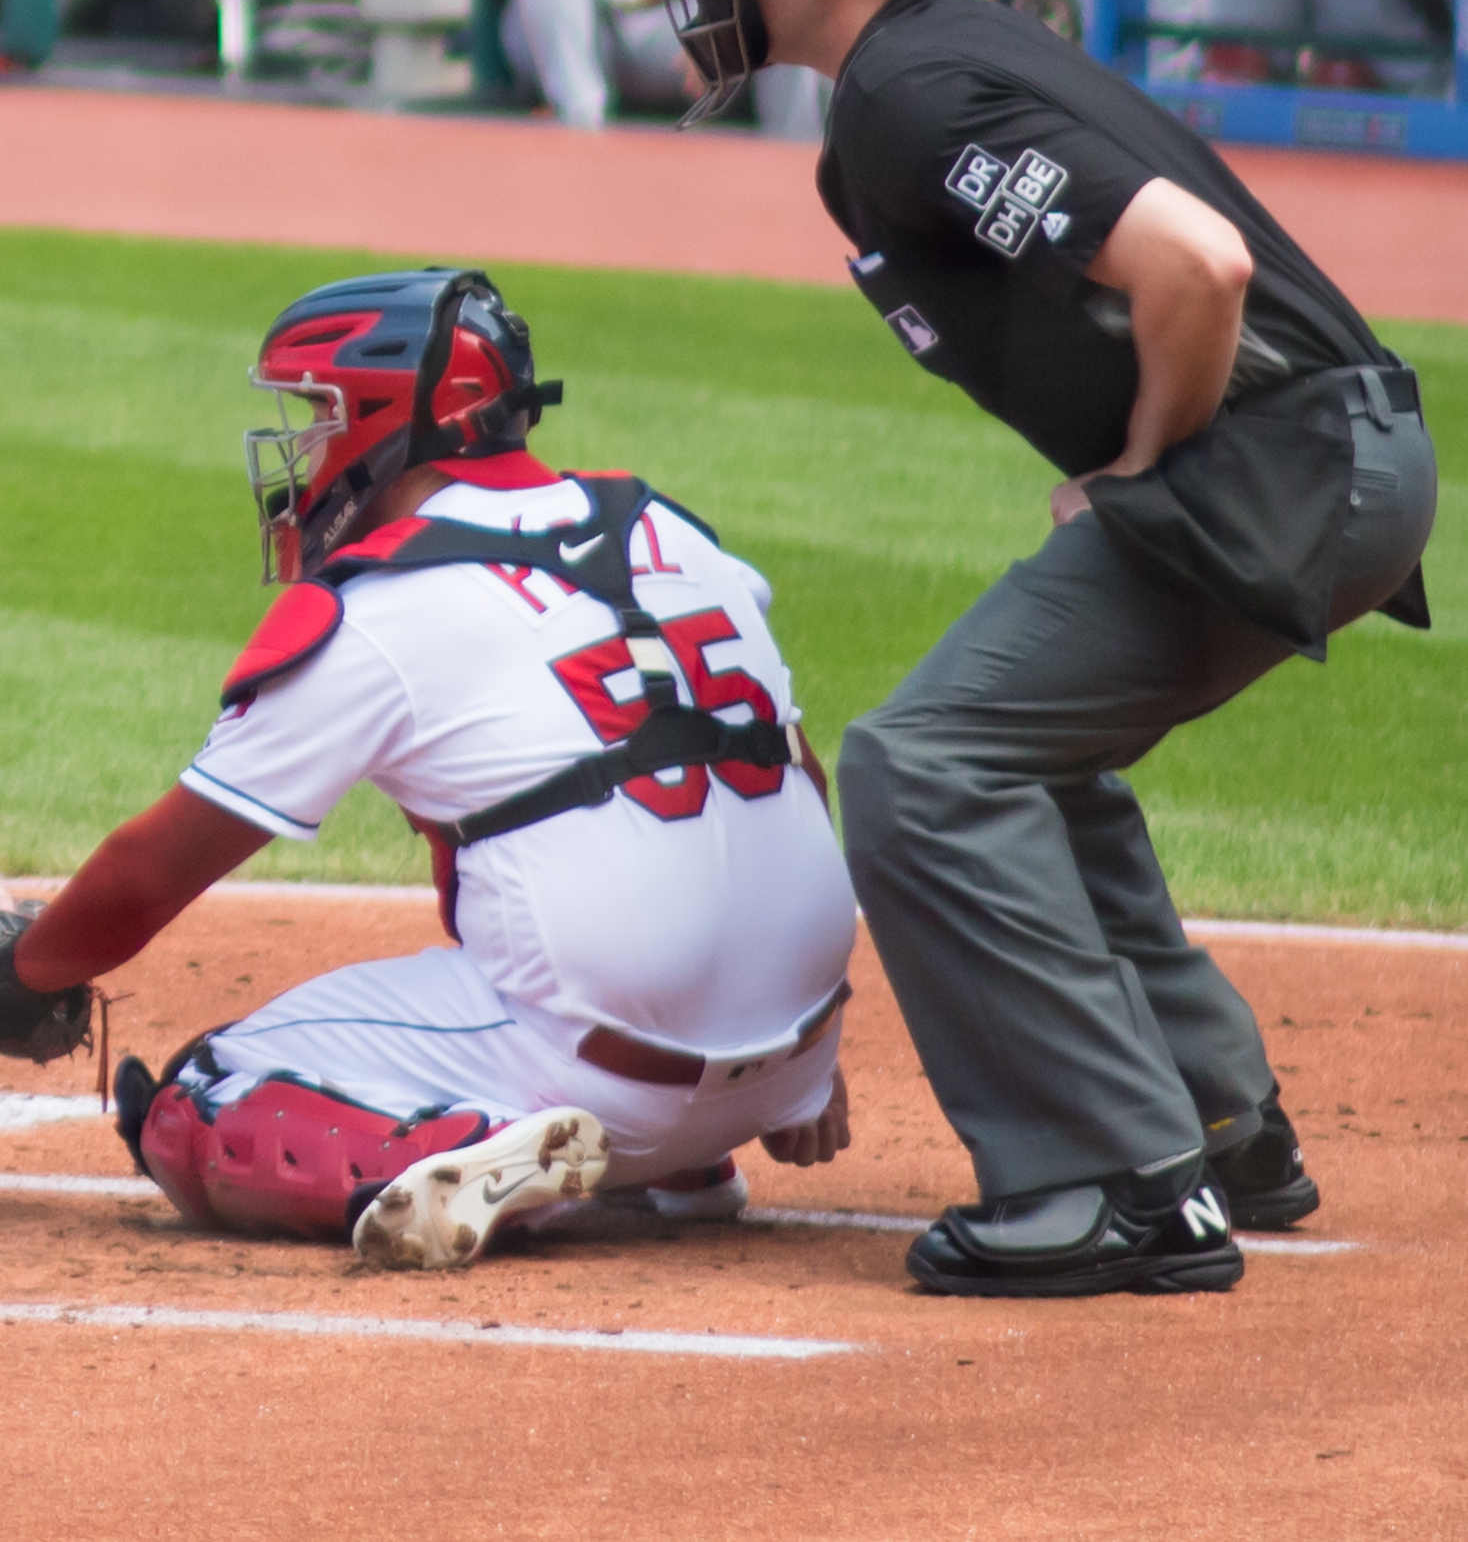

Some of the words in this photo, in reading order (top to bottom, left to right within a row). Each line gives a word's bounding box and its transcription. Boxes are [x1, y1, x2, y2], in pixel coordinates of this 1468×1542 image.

[956, 154, 1000, 200] DR
[987, 201, 1027, 247] DH
[1013, 156, 1057, 205] BE
[546, 604, 786, 824] 55
[1181, 1186, 1227, 1241] N
